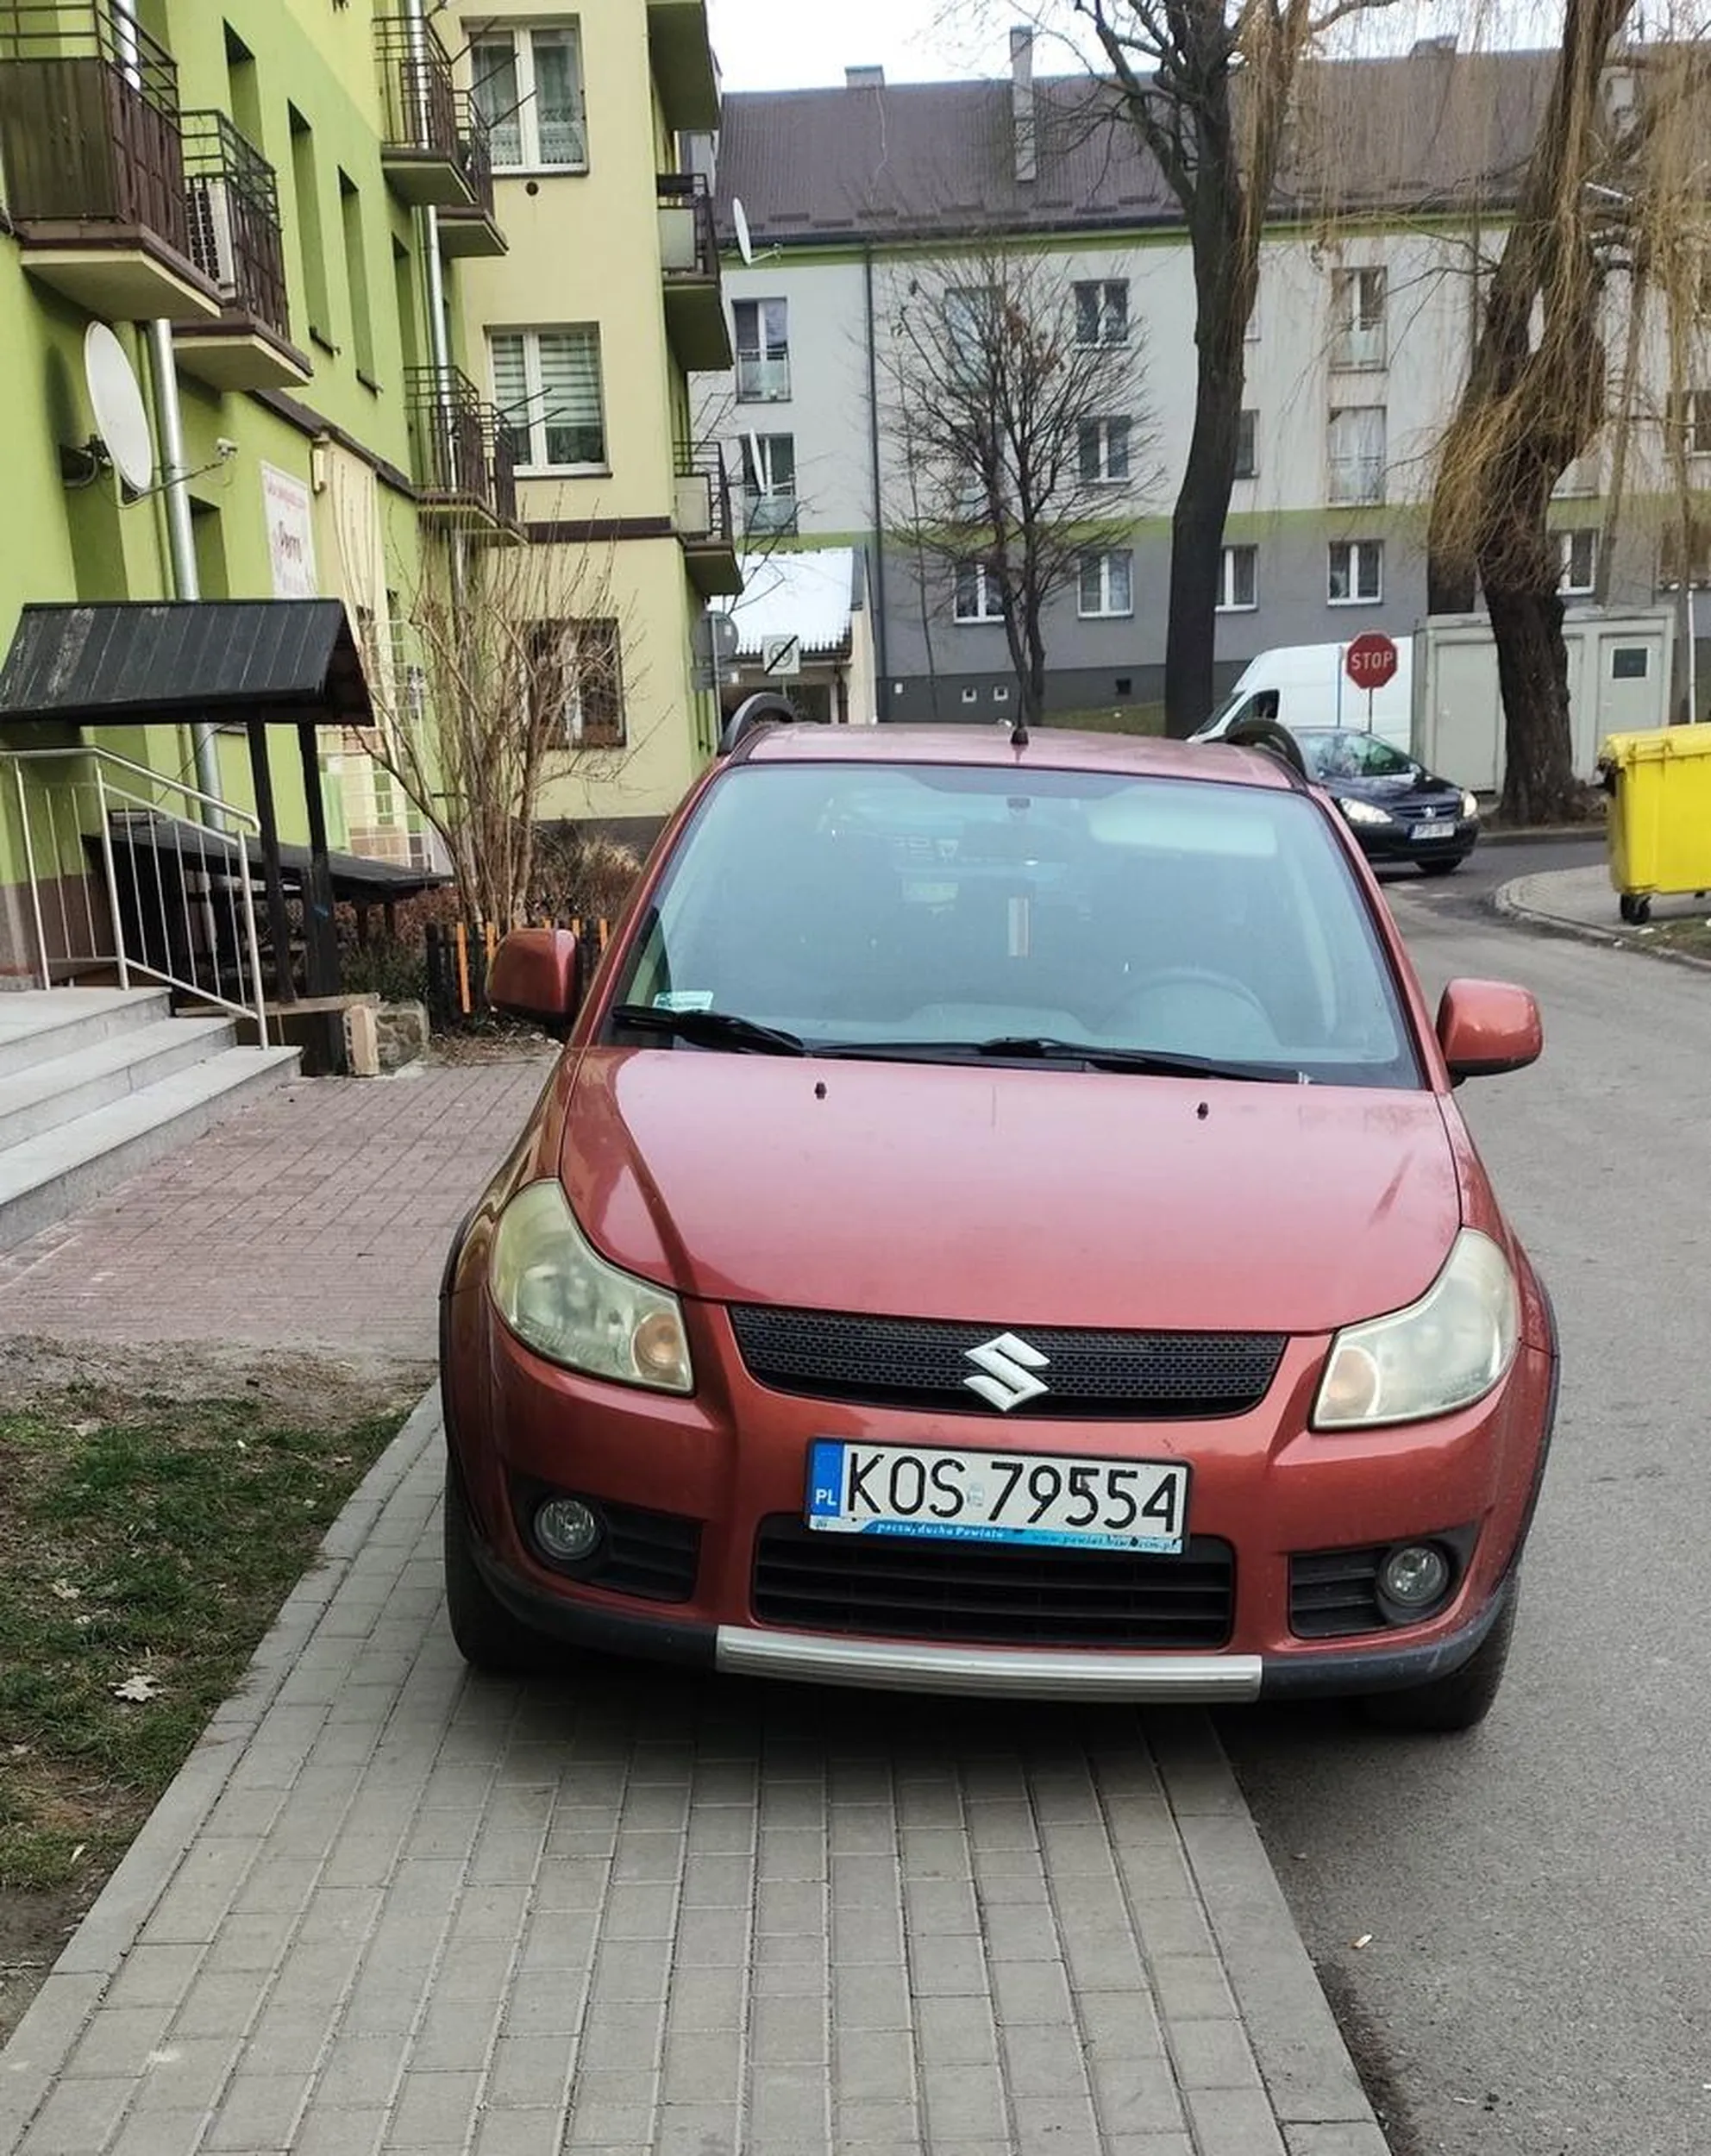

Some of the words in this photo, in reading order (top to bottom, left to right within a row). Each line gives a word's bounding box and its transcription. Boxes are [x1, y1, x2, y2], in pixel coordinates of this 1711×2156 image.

[1351, 650, 1393, 670] STOP
[815, 1489, 837, 1507] PL
[848, 1452, 965, 1518] KOS
[988, 1461, 1177, 1532] 79554
